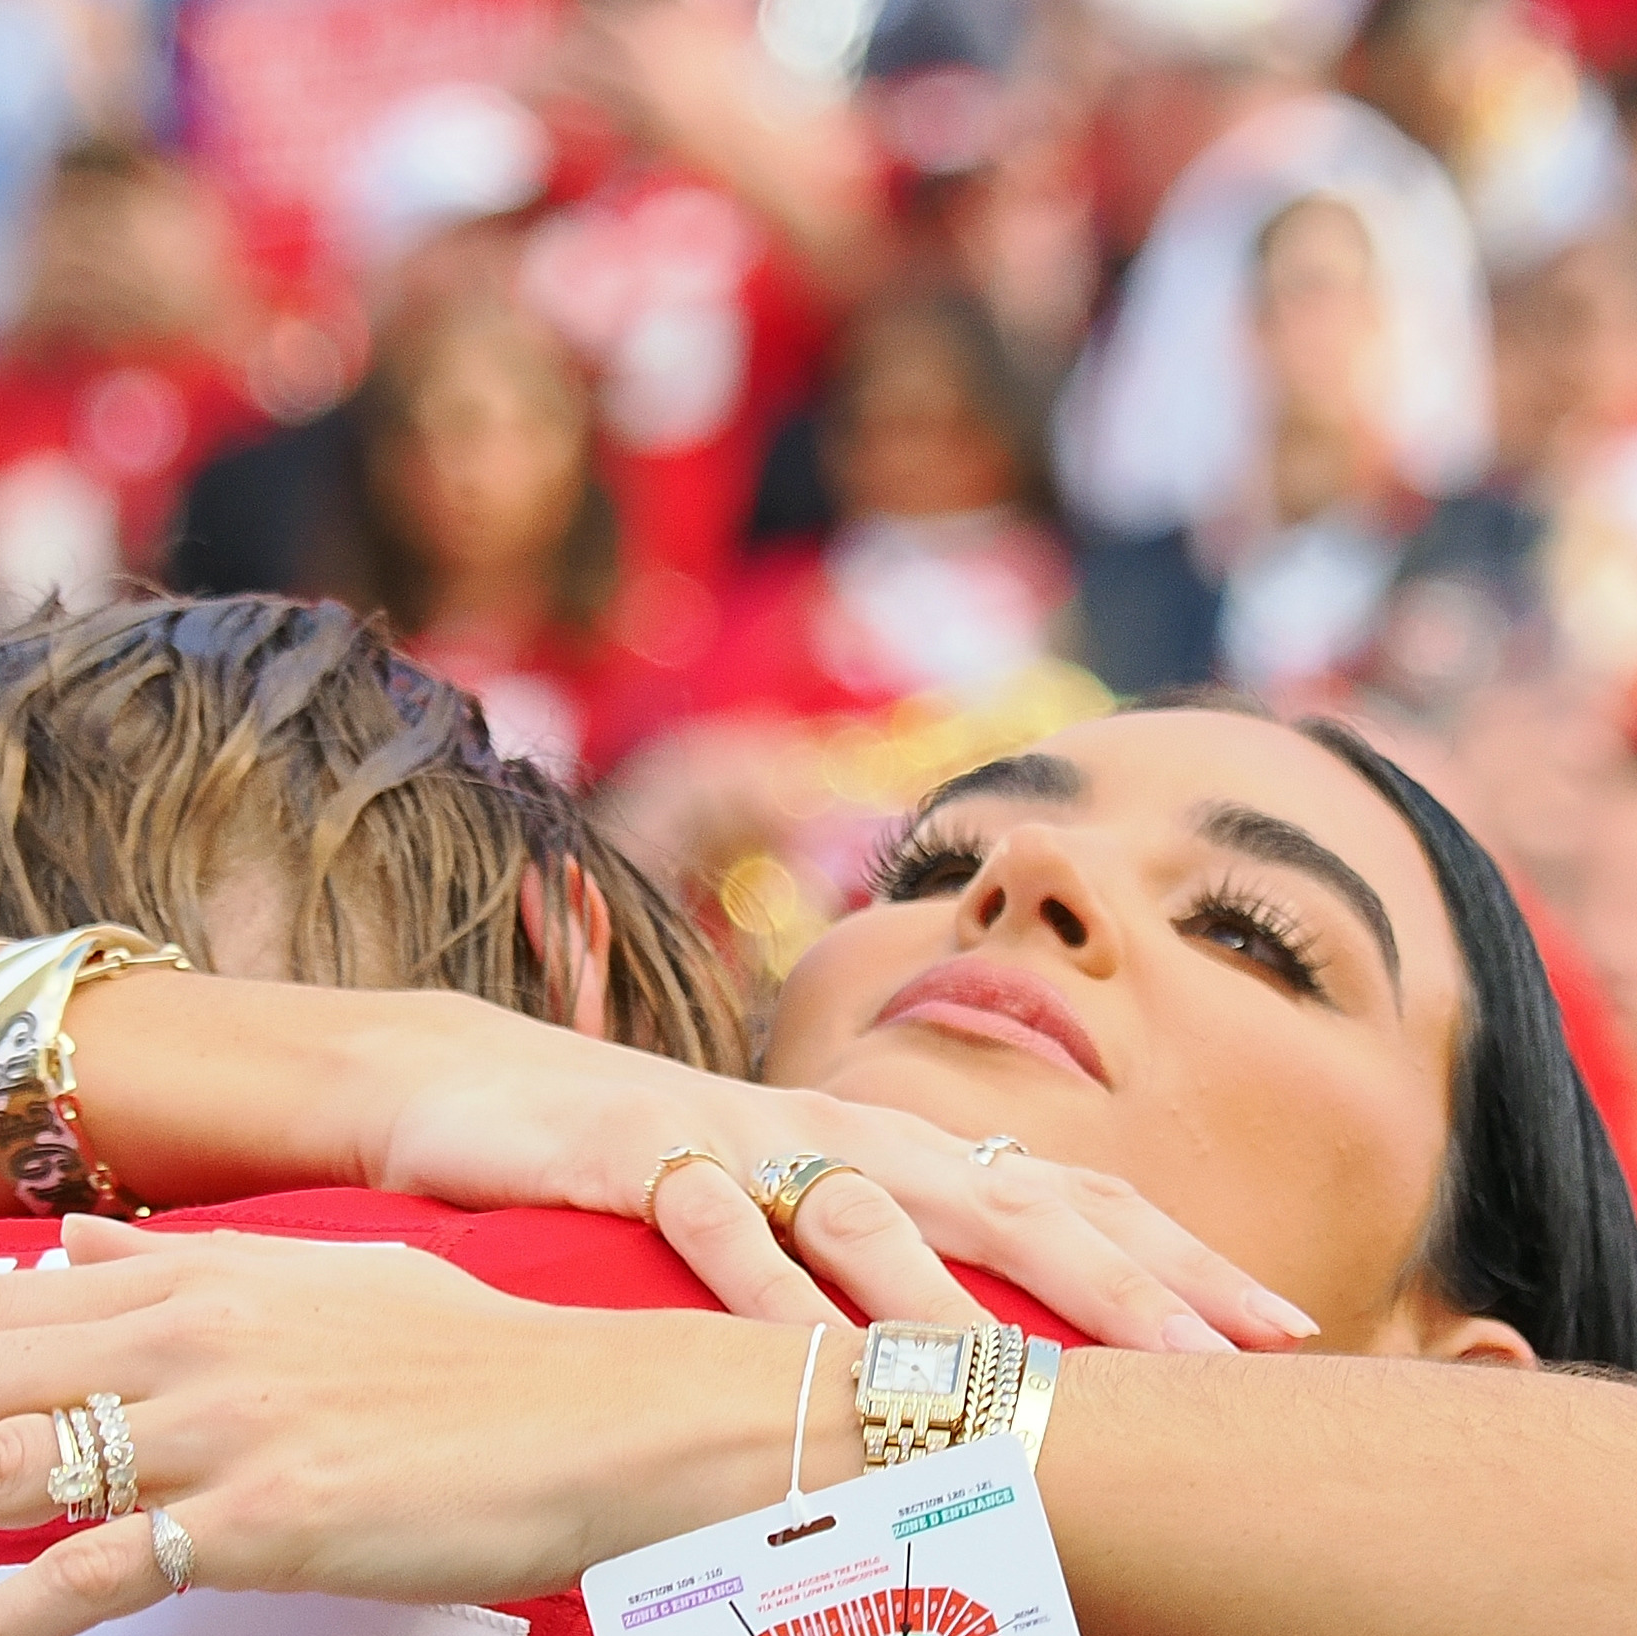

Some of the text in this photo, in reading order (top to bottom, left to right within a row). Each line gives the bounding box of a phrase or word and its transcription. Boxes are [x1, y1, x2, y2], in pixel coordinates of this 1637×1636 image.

[893, 1515, 928, 1538] ZONE
[941, 1489, 1013, 1522] ENTRANCE
[898, 1495, 944, 1517] SECTION
[833, 1565, 851, 1579] THE
[624, 1603, 659, 1627] ZONE
[671, 1578, 743, 1612] ENTRANCE
[628, 1582, 674, 1605] SECTION
